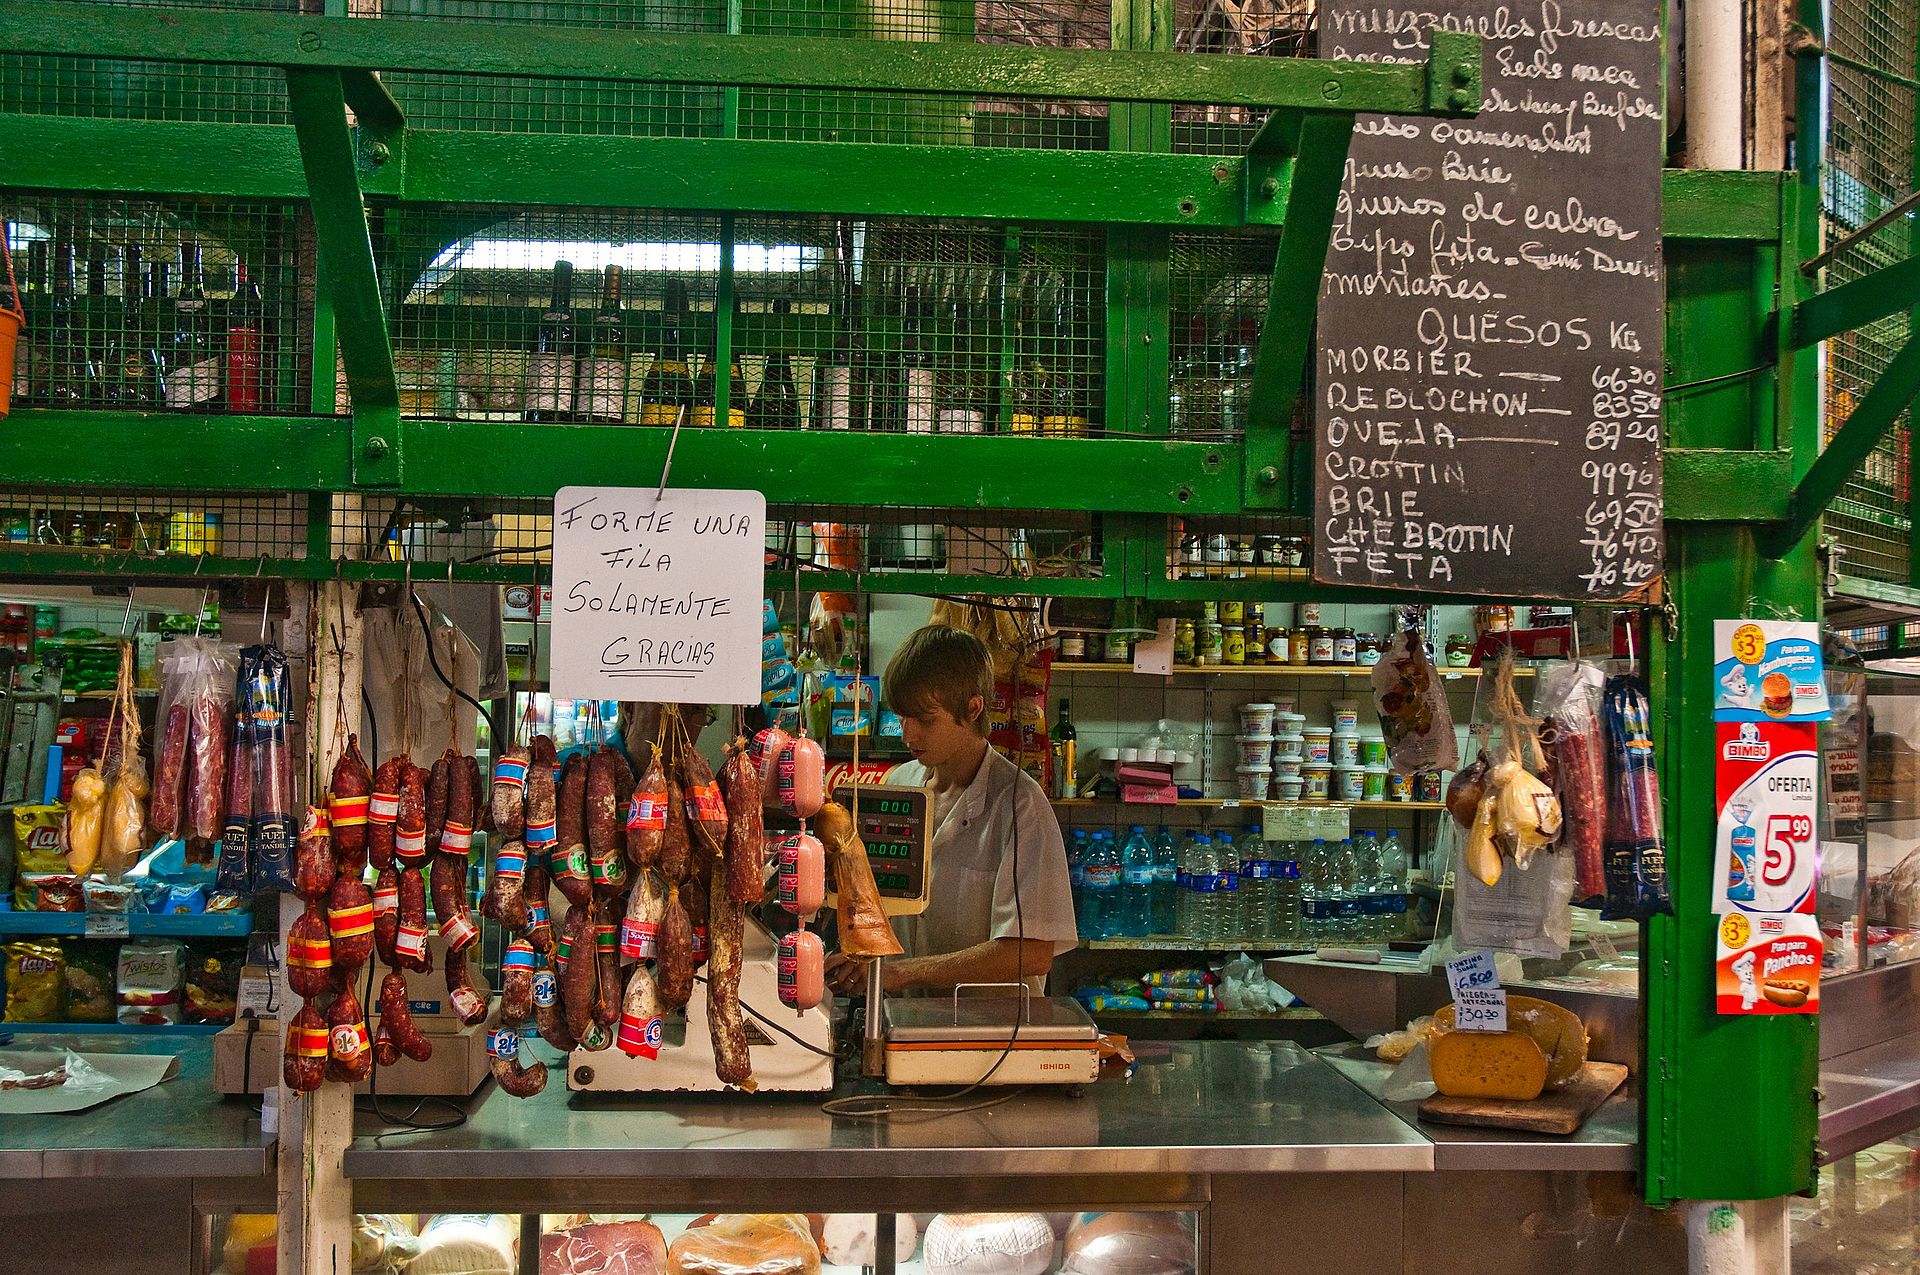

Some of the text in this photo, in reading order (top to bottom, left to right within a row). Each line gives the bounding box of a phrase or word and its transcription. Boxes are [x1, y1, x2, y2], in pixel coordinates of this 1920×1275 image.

[1352, 116, 1421, 139] ueso
[1442, 150, 1513, 184] Brie
[1462, 191, 1515, 226] de
[1327, 345, 1482, 378] MORBIER
[1327, 382, 1529, 416] REBLOCHON
[1327, 417, 1456, 450] OVEJA
[560, 496, 750, 537] FORME UNA
[1328, 486, 1424, 518] BRIE
[1326, 547, 1453, 581] FETA
[563, 580, 731, 620] SOLAMENTE
[601, 636, 715, 666] GRACIAS
[1794, 686, 1819, 695] BIMBO
[1728, 745, 1768, 757] BIMBO
[1768, 776, 1813, 792] OFERTA
[261, 831, 287, 841] FUET
[261, 842, 288, 850] TANDIL
[1759, 921, 1783, 930] BIMBO
[1770, 941, 1808, 953] Pan para
[1762, 951, 1815, 979] Panchos
